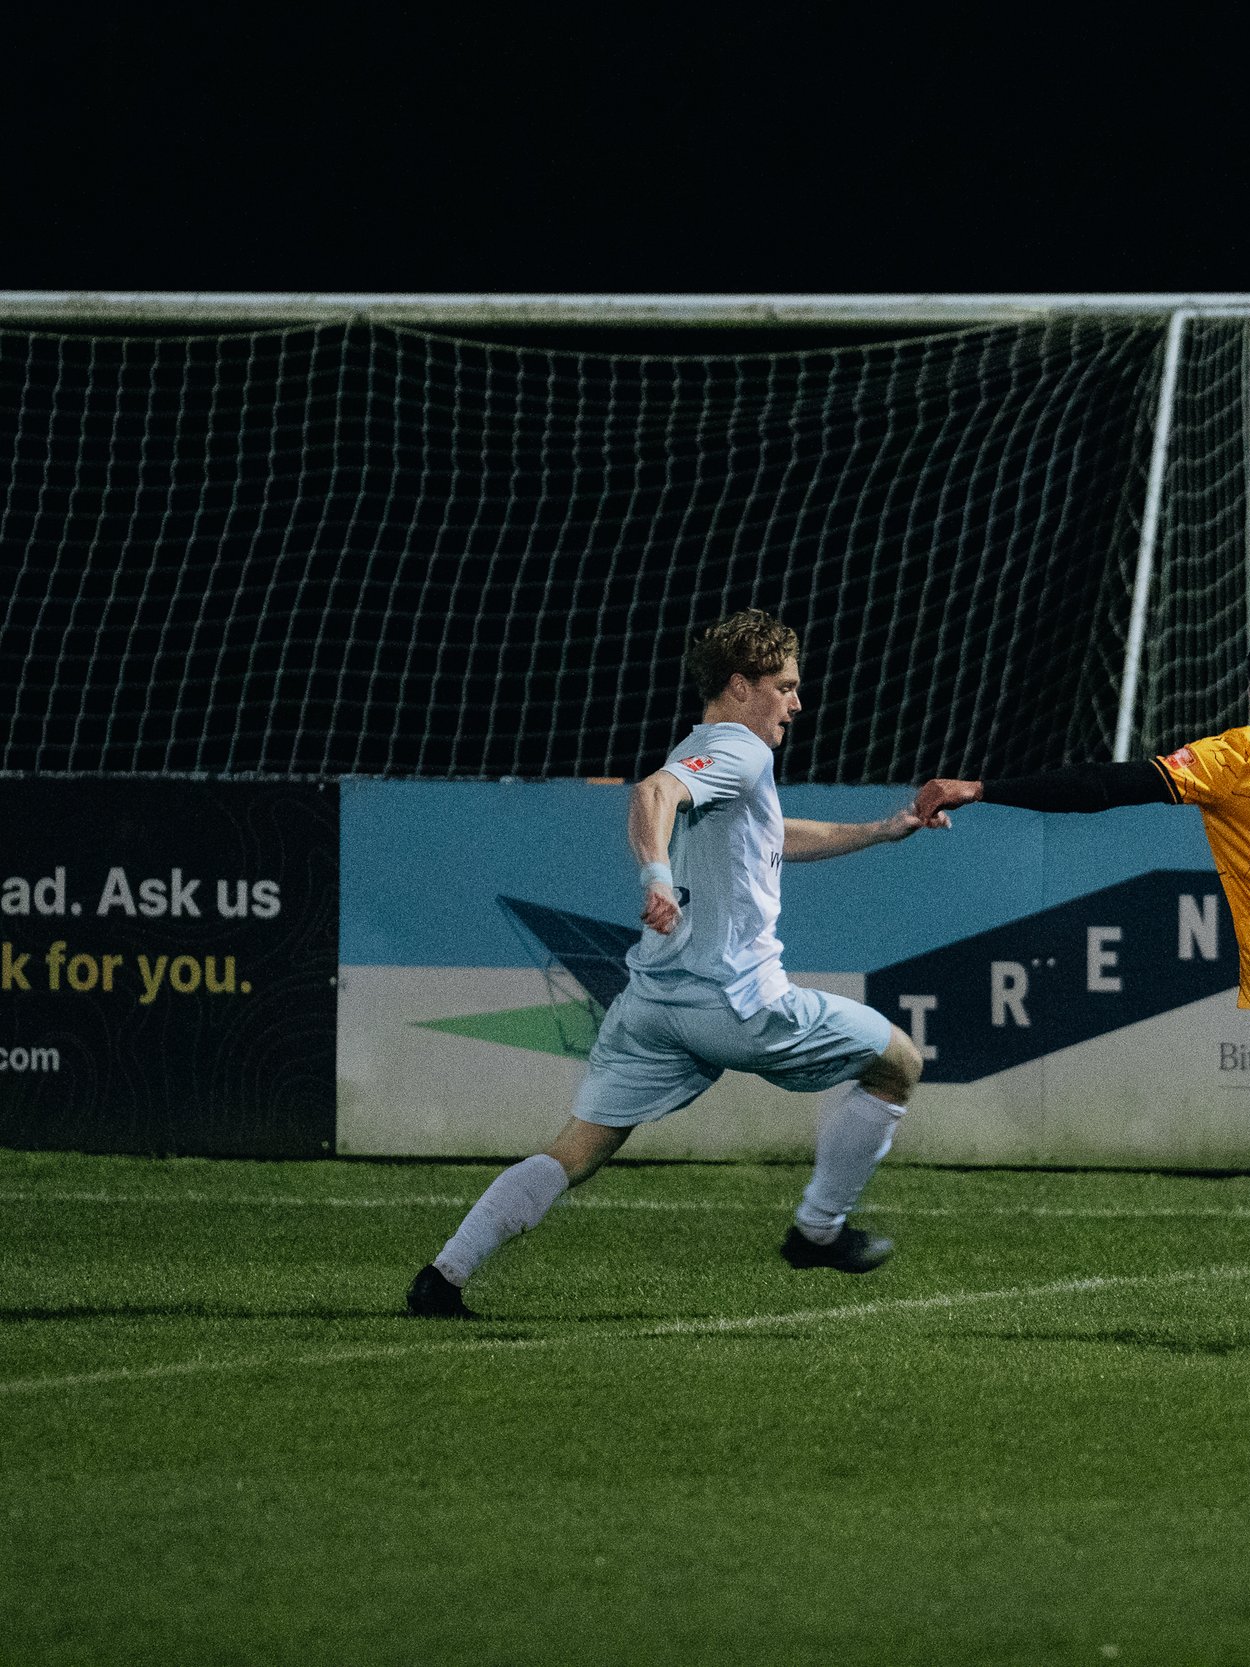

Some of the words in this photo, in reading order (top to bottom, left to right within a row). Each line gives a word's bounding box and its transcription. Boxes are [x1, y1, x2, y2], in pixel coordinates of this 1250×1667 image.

[97, 866, 201, 917] Ask
[217, 879, 281, 918] us
[45, 940, 124, 992] for
[137, 954, 252, 1004] you.
